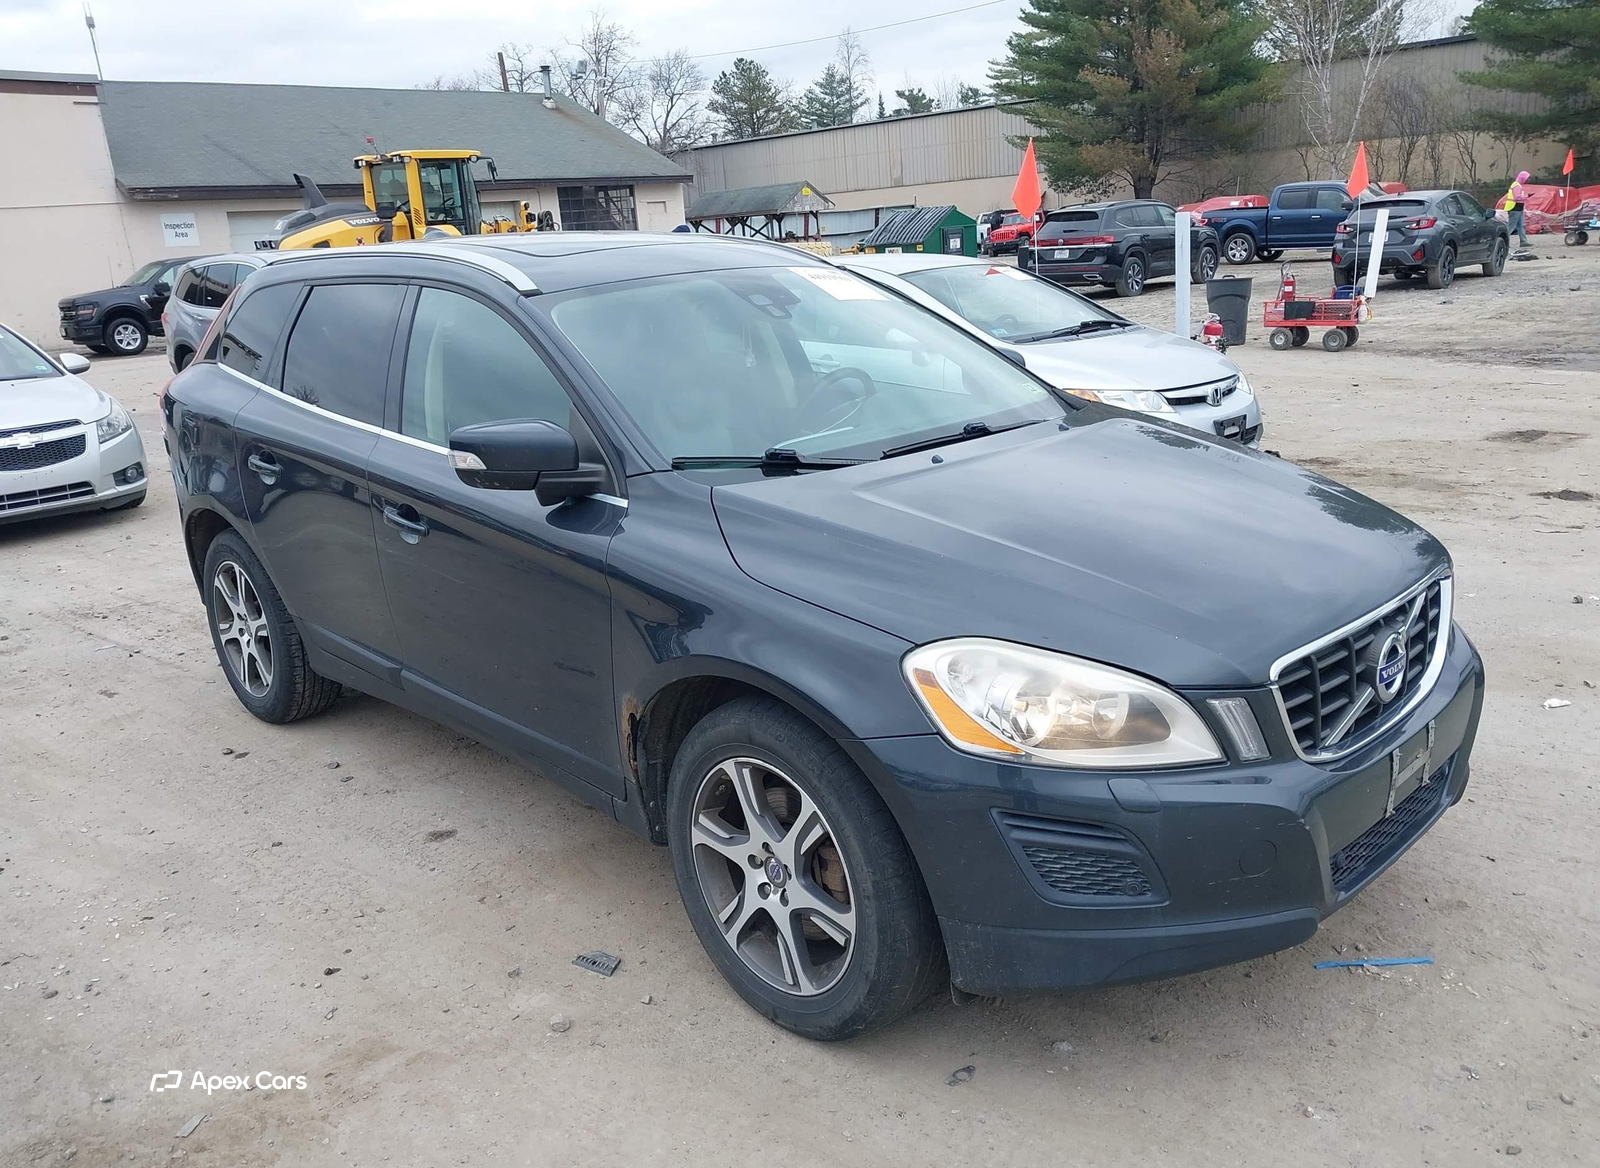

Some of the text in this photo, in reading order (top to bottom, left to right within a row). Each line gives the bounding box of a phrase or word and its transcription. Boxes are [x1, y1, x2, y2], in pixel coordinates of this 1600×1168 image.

[348, 217, 380, 225] VOLVO
[163, 221, 195, 231] Inspection
[174, 230, 189, 238] Area
[1381, 661, 1403, 679] VOLV
